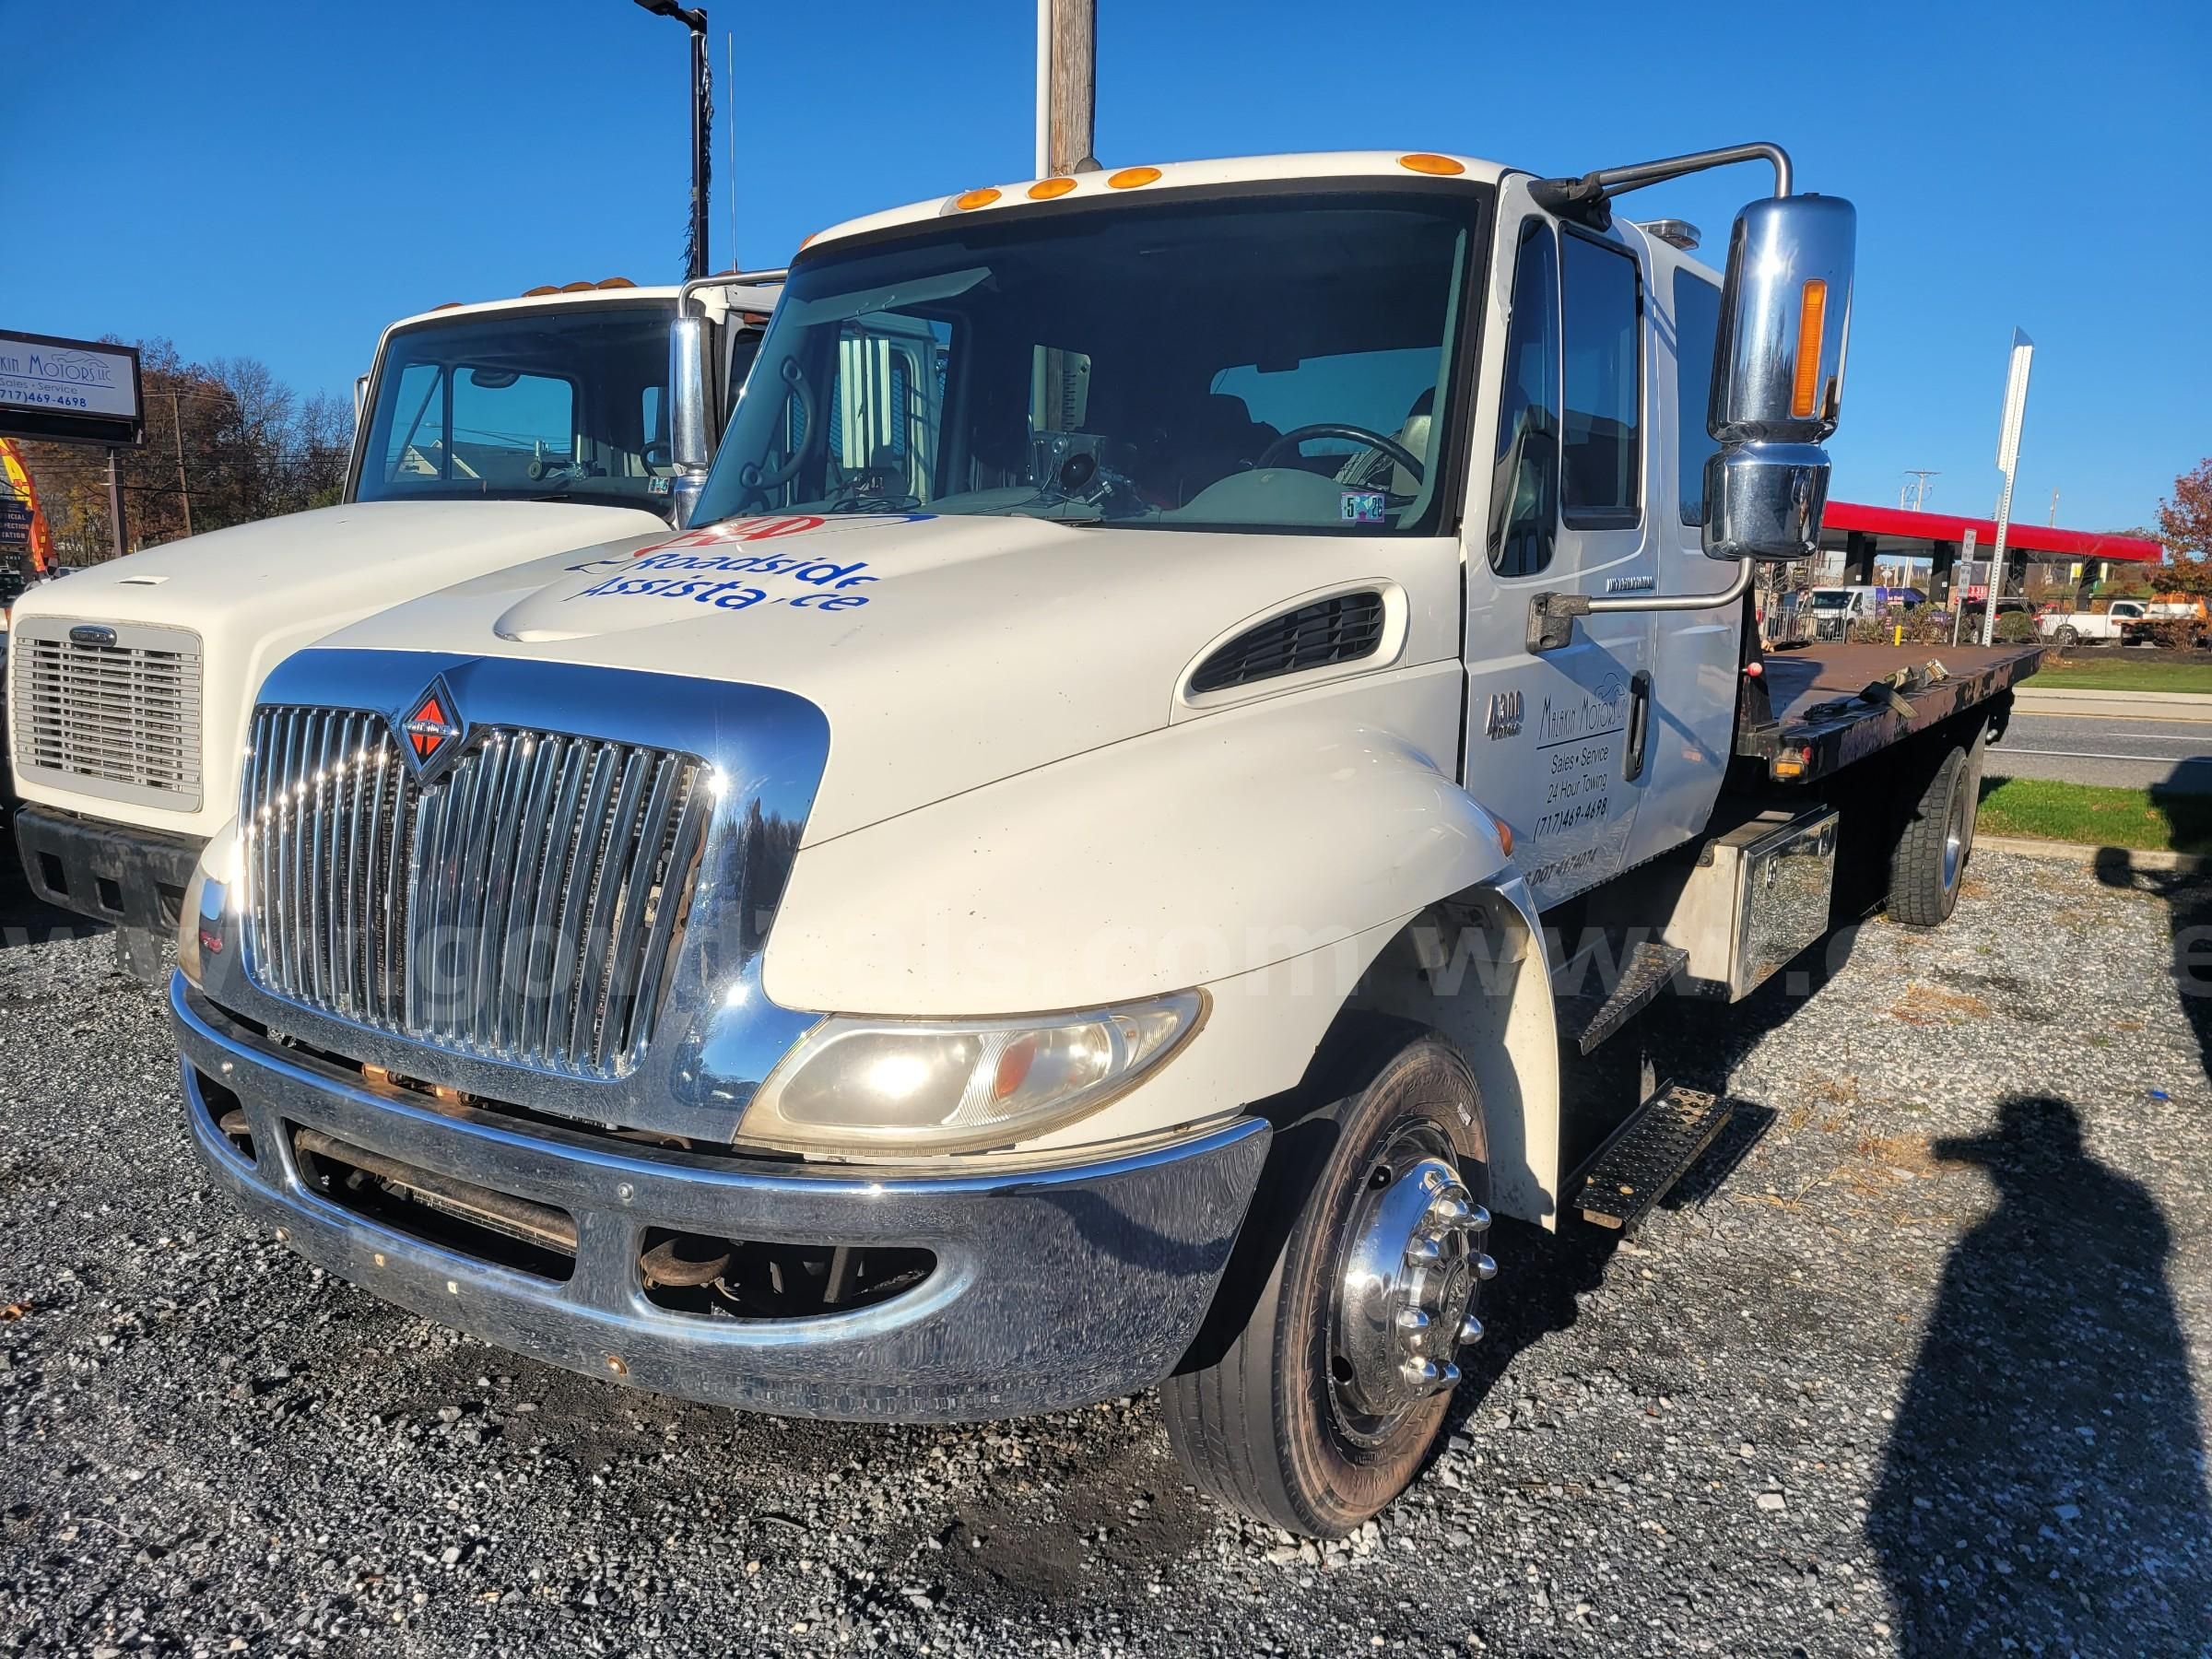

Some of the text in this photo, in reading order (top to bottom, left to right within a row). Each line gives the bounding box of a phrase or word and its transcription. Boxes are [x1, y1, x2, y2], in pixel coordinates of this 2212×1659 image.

[38, 382, 79, 394] Service
[560, 575, 870, 611] Assistace
[1551, 747, 1609, 774] Sales Service
[1547, 773, 1607, 805] 24 Hour Towing
[1533, 797, 1607, 843] (717)469-4698
